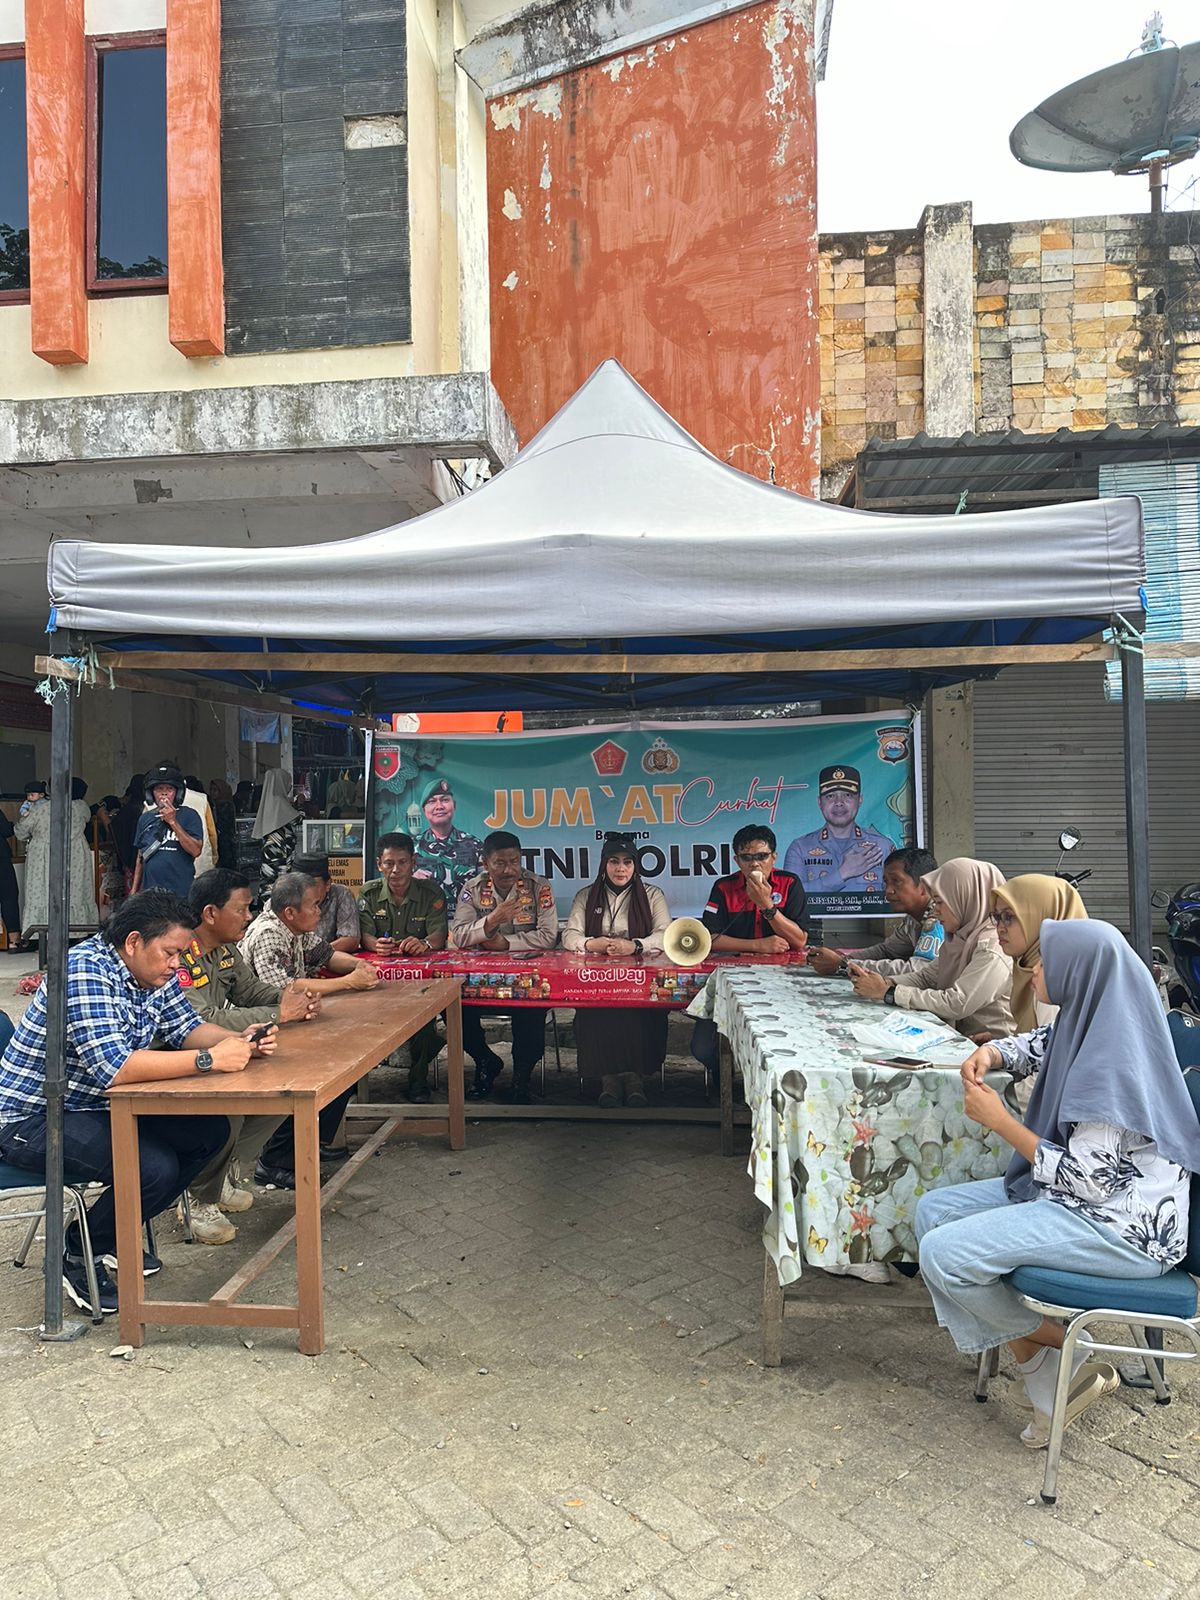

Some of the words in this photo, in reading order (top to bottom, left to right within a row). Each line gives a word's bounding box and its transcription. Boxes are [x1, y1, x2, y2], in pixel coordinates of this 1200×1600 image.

[676, 775, 809, 827] Curhat
[520, 846, 589, 880] TNI
[637, 843, 732, 878] OLRI
